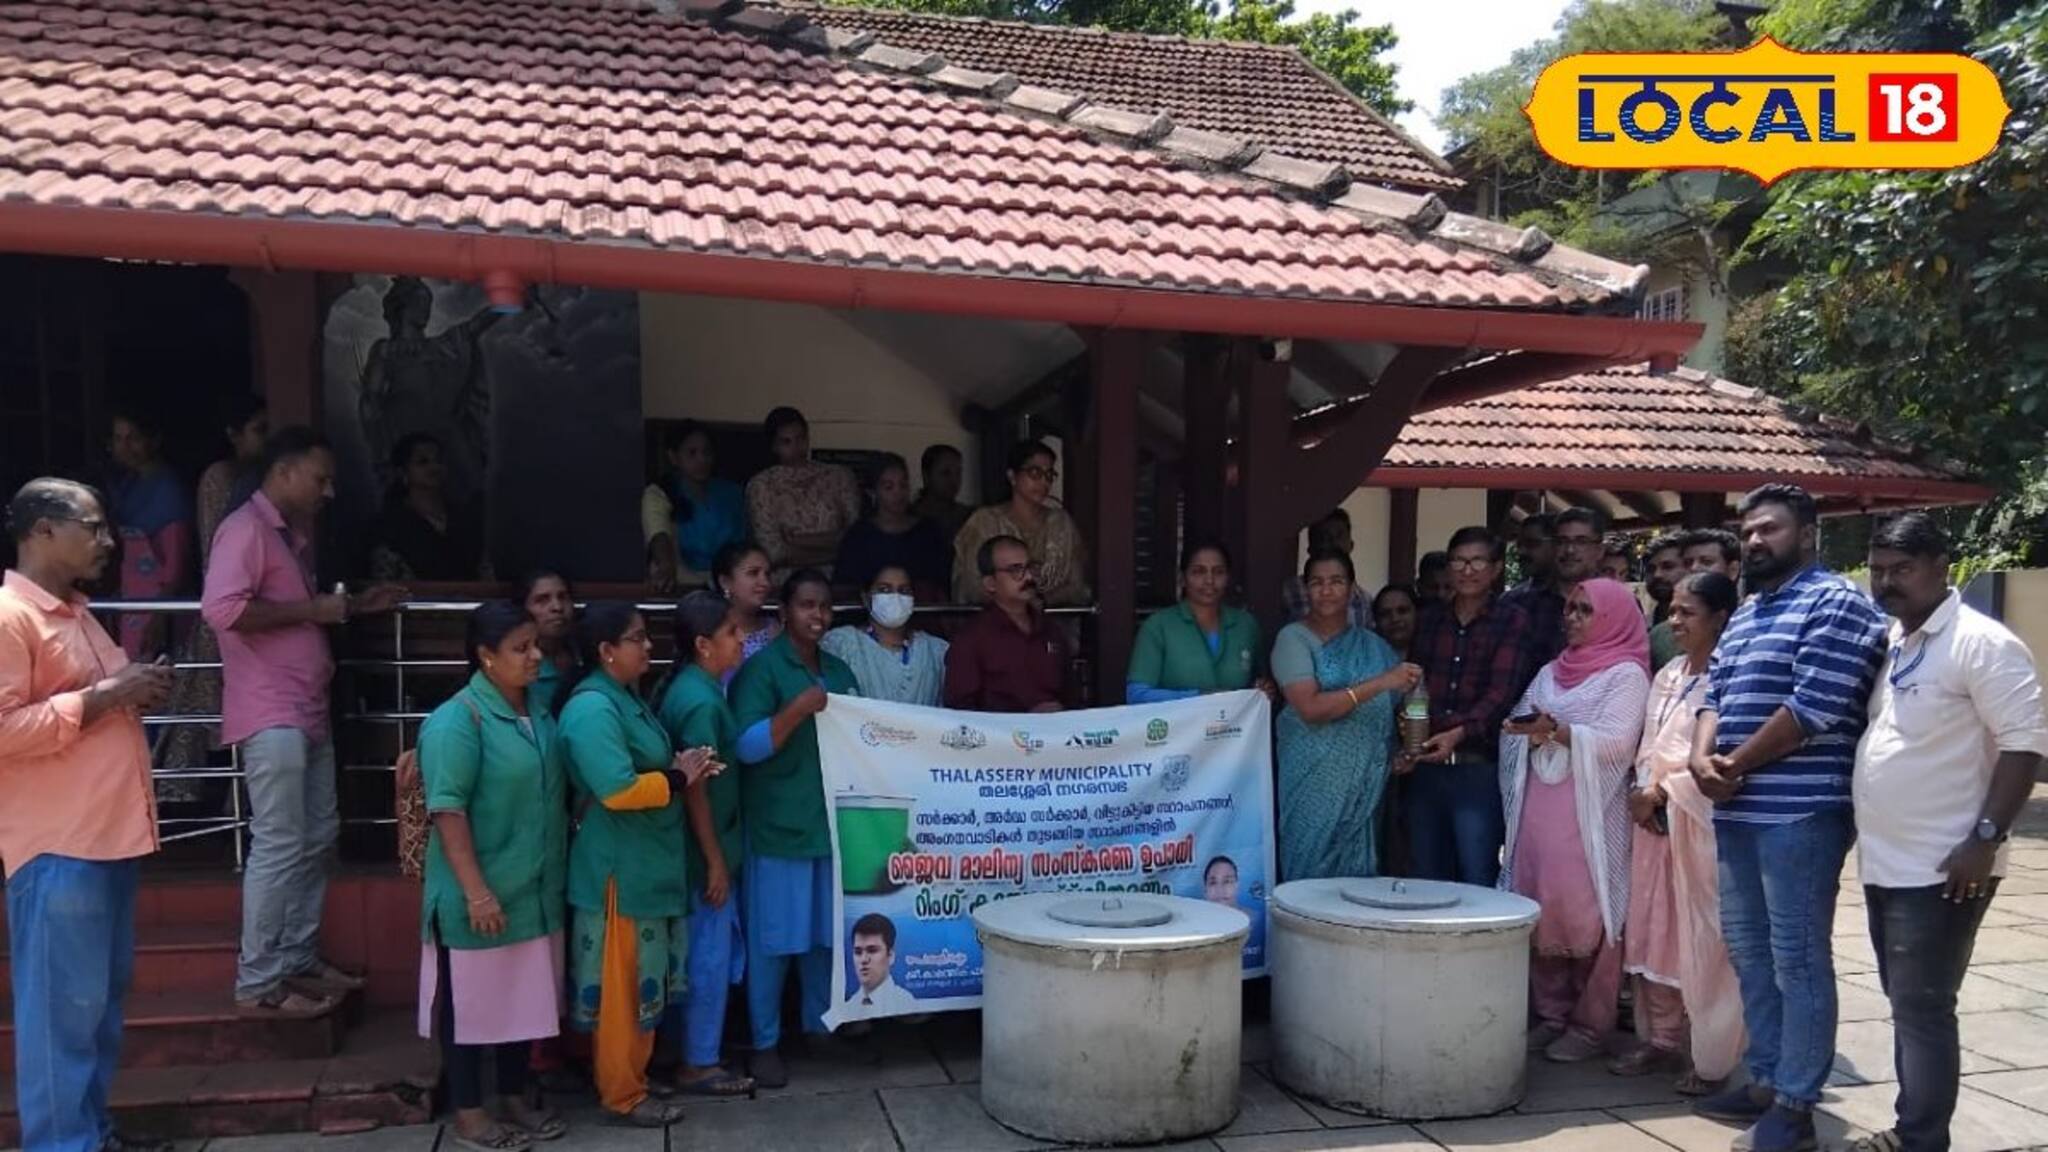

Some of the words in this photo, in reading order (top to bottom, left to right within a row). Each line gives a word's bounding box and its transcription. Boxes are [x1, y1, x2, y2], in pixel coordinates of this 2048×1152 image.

[929, 767, 1035, 783] THALASSERY
[1039, 763, 1152, 782] MUNICIPALITY
[1056, 781, 1128, 797] നഗരസഭ
